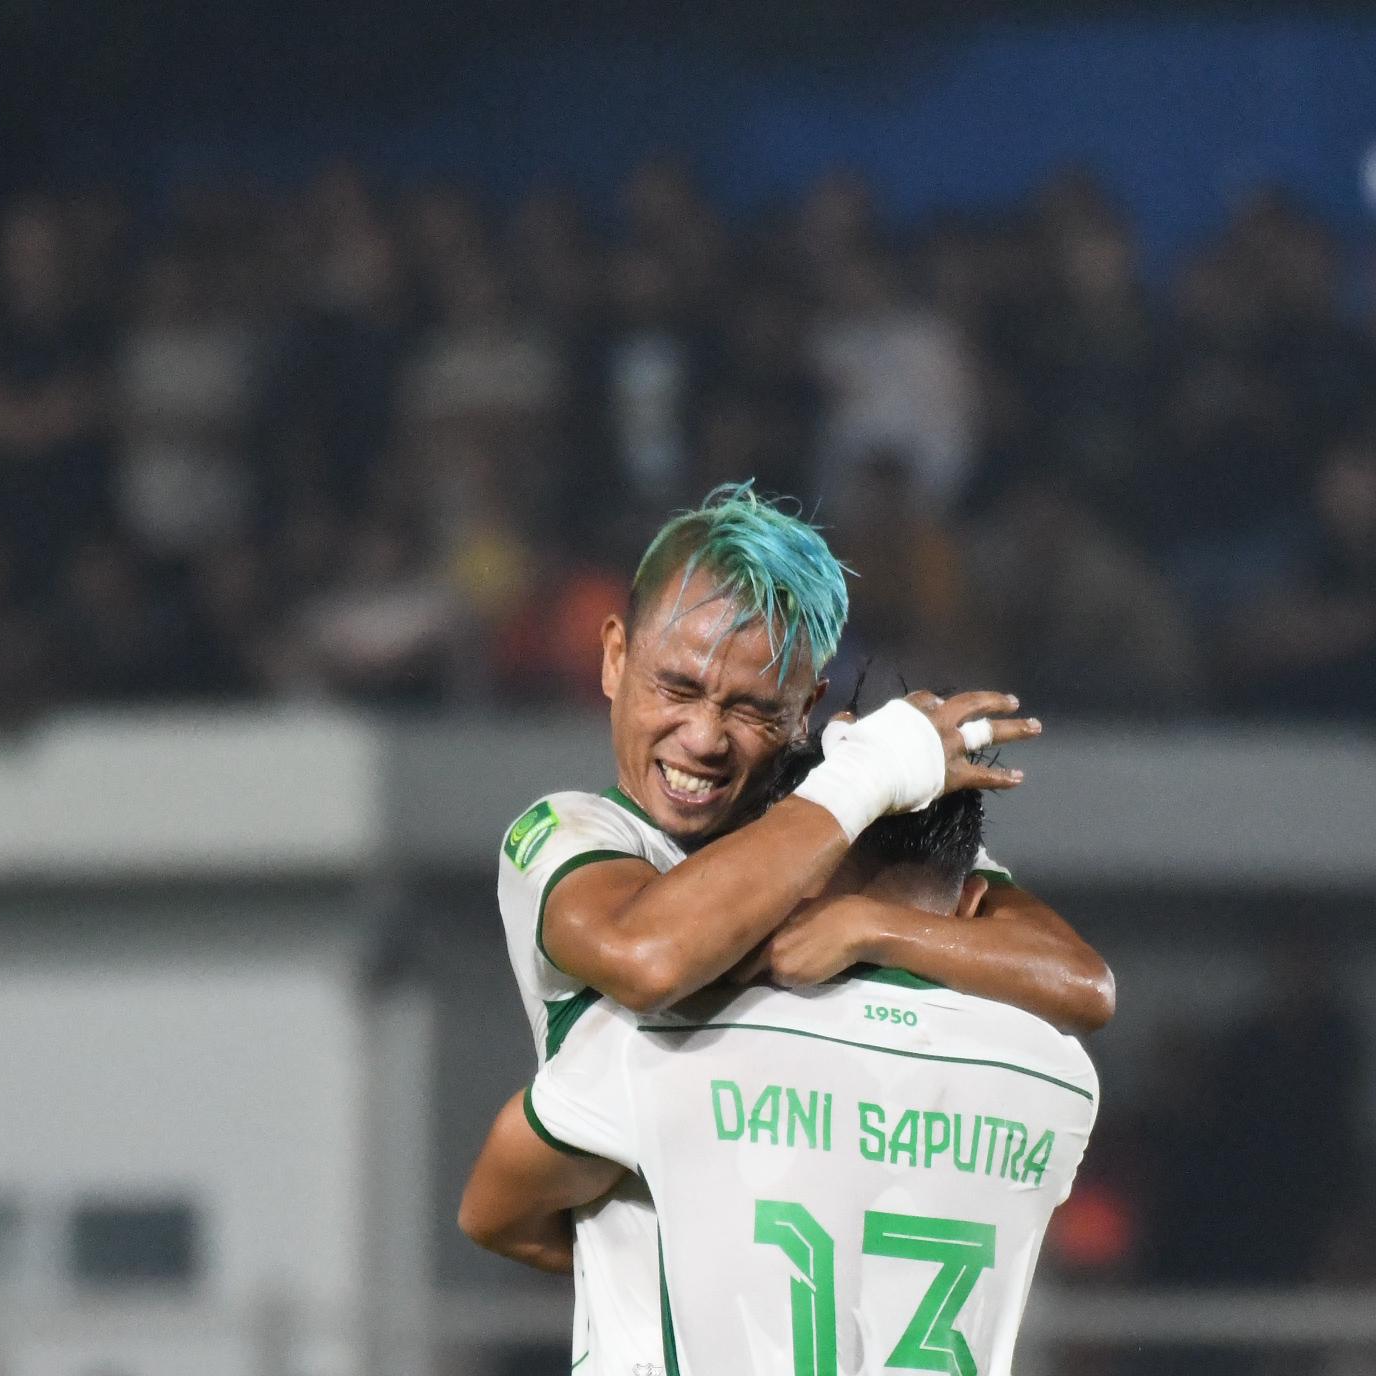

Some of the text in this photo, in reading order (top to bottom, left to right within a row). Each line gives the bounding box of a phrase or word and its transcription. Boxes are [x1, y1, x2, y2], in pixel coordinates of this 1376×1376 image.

[864, 1004, 918, 1027] 1950
[710, 1079, 1055, 1187] DANI SAPUTRA
